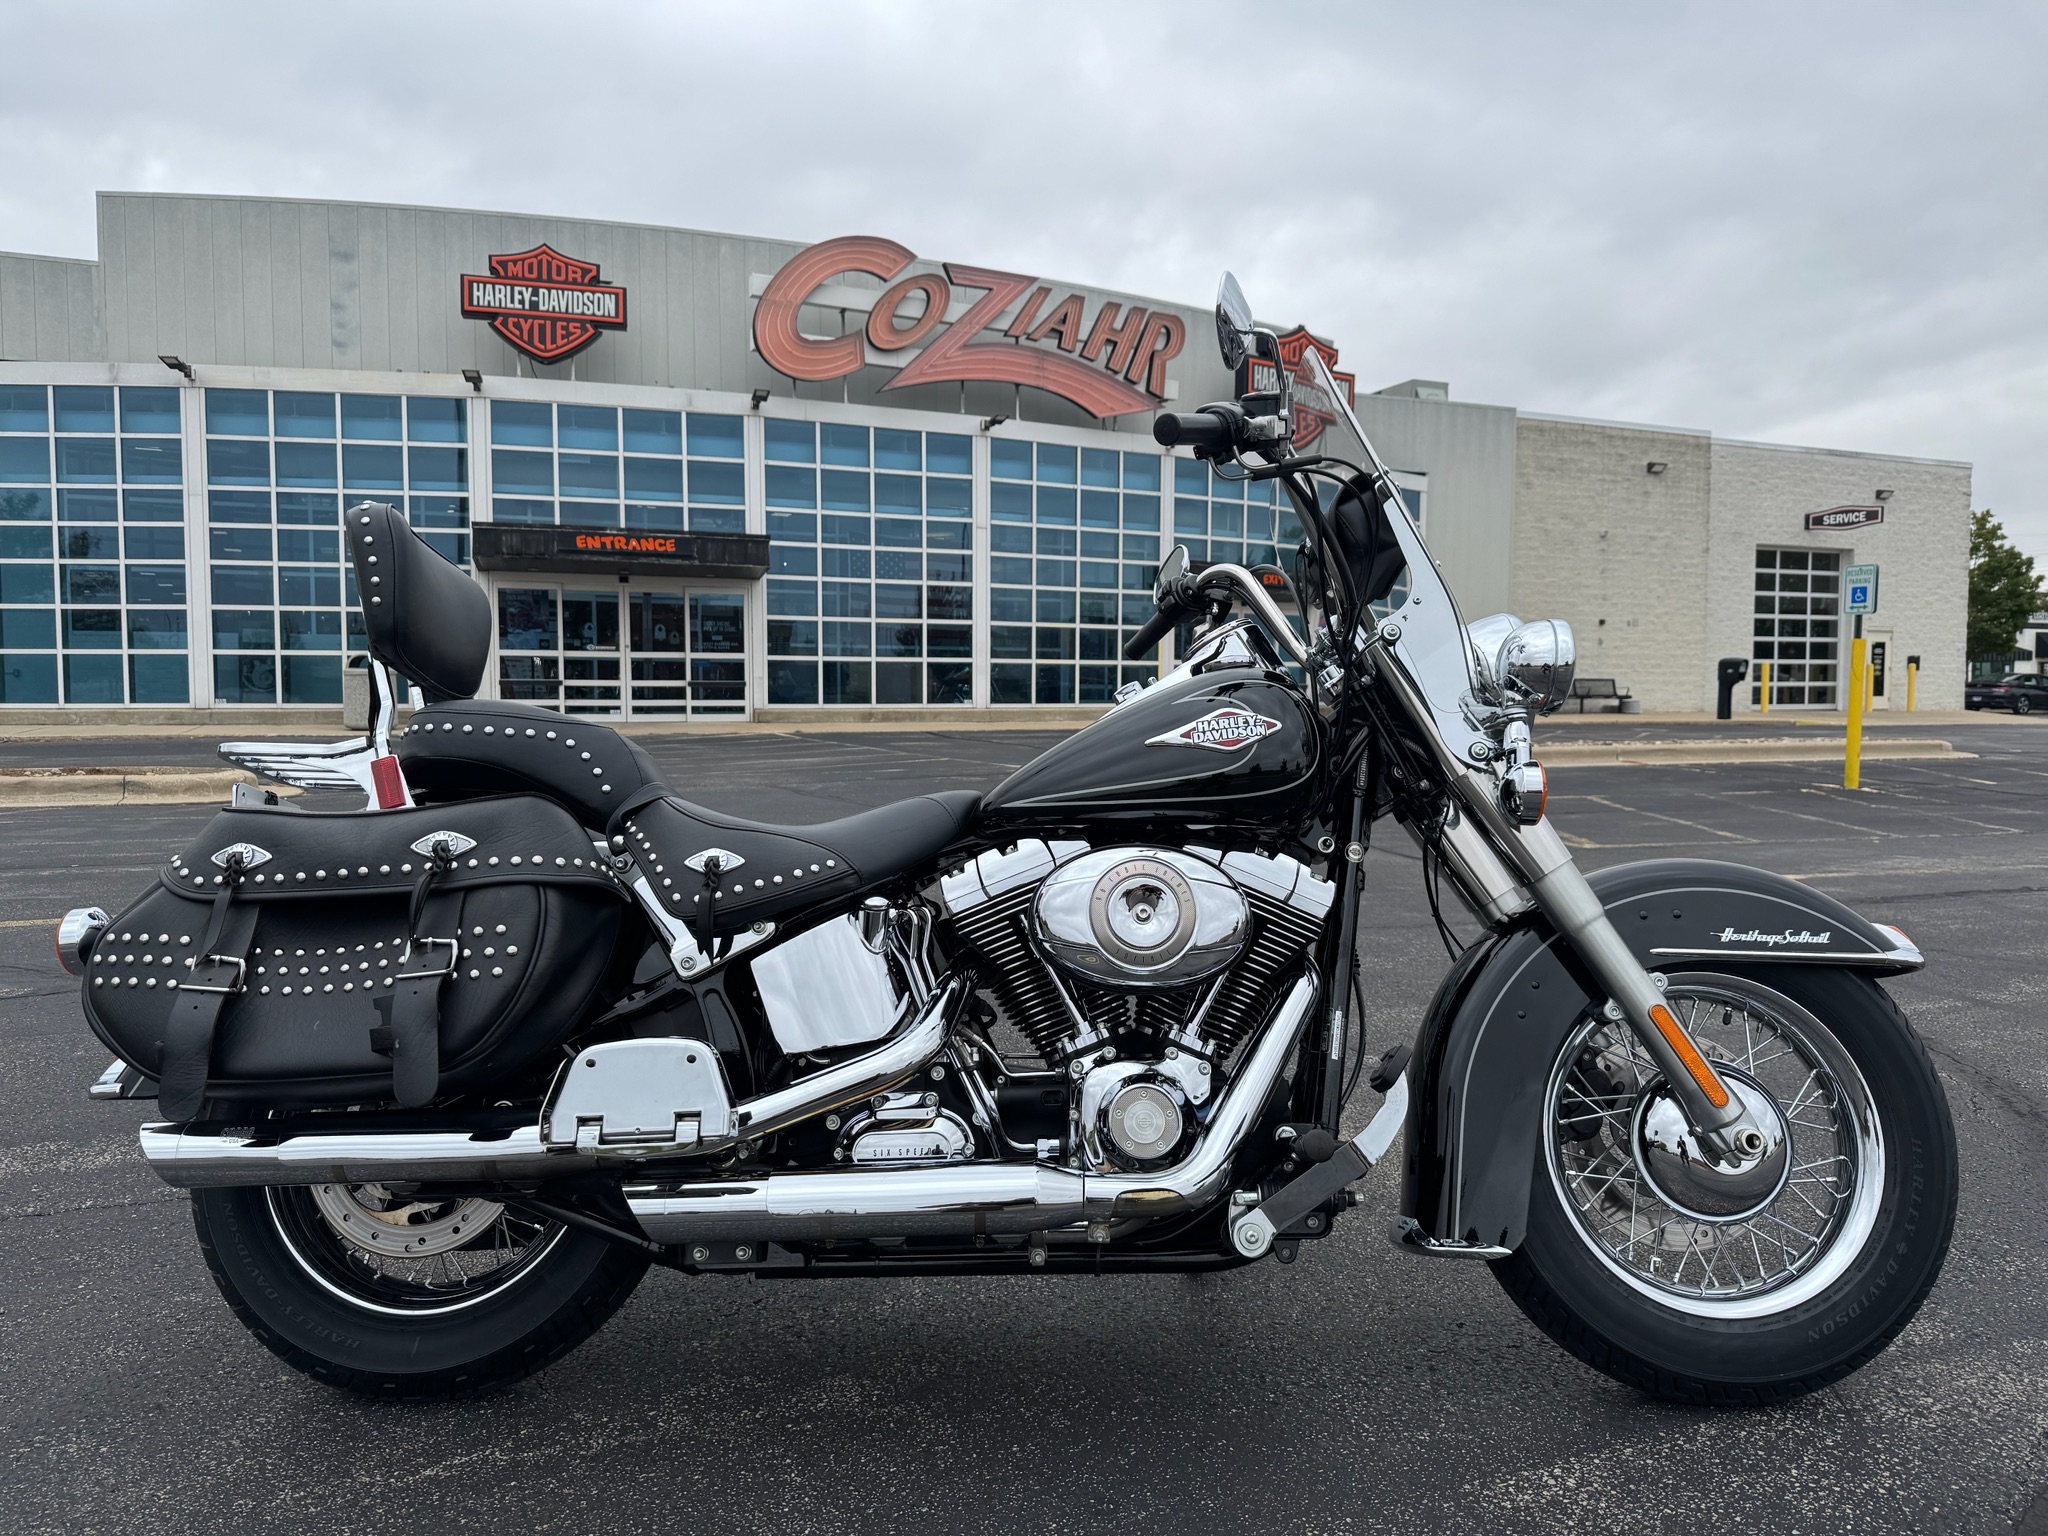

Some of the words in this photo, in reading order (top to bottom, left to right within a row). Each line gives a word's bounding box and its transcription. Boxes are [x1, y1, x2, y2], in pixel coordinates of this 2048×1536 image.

[507, 253, 583, 283] MOTOR
[472, 282, 616, 317] HARLEY-DAVIDSON
[507, 317, 582, 350] CYCLES
[1822, 511, 1867, 526] SERVICE
[576, 534, 676, 552] ENTRANCE
[1847, 568, 1873, 577] RESERVED
[1196, 715, 1263, 731] HARLEY-
[1192, 725, 1267, 744] DAVIDSON
[873, 1149, 891, 1157] SIX
[898, 1147, 932, 1156] SPEED
[1904, 1136, 1925, 1240] HARLEY
[1808, 1257, 1900, 1344] DAVIDSON
